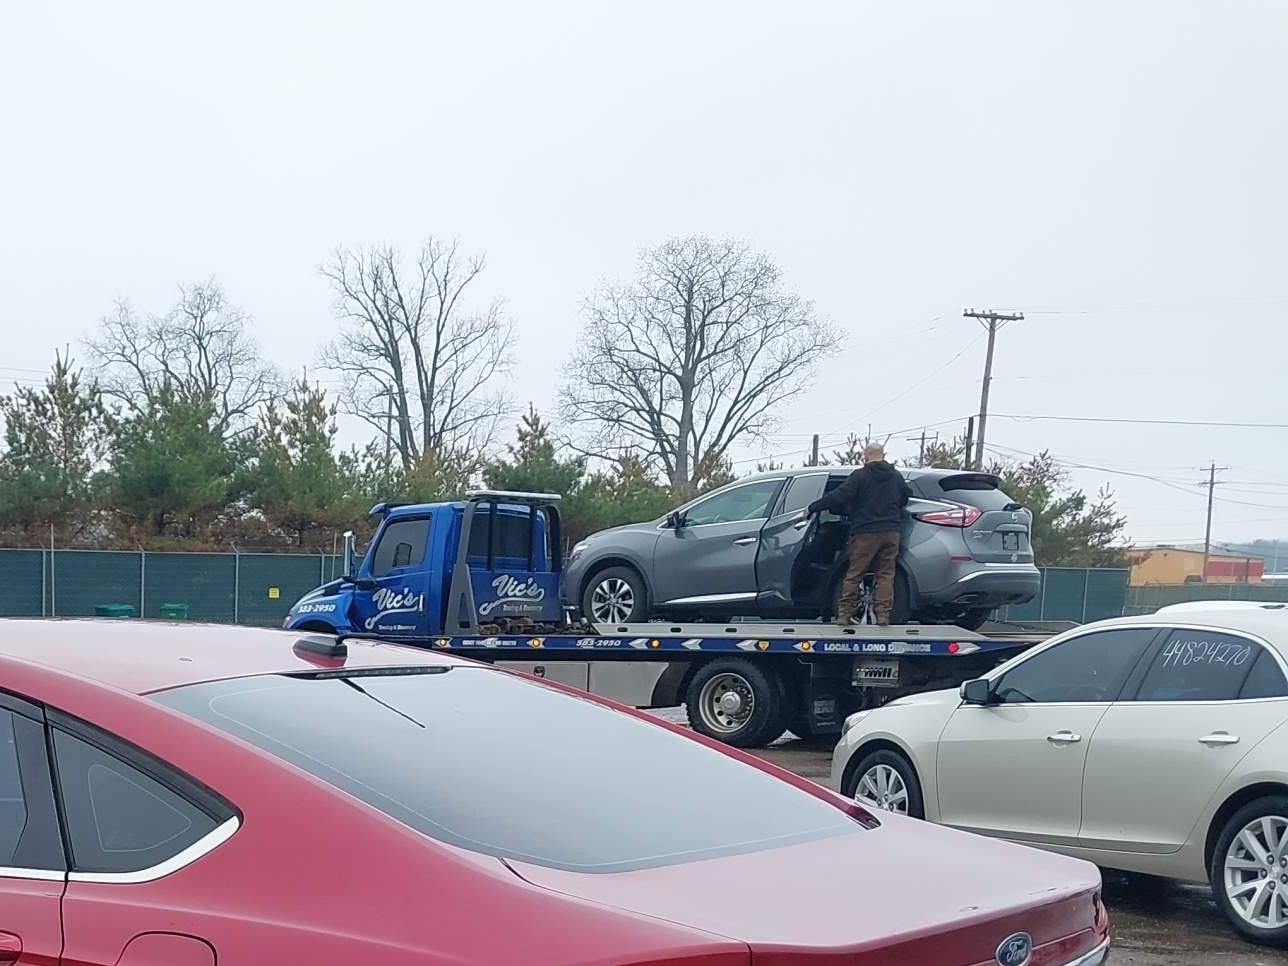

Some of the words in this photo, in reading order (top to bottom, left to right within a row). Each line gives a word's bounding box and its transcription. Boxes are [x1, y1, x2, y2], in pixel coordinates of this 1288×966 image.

[372, 587, 419, 611] Vic's
[492, 574, 544, 600] Vic's
[1162, 639, 1251, 668] 44824270
